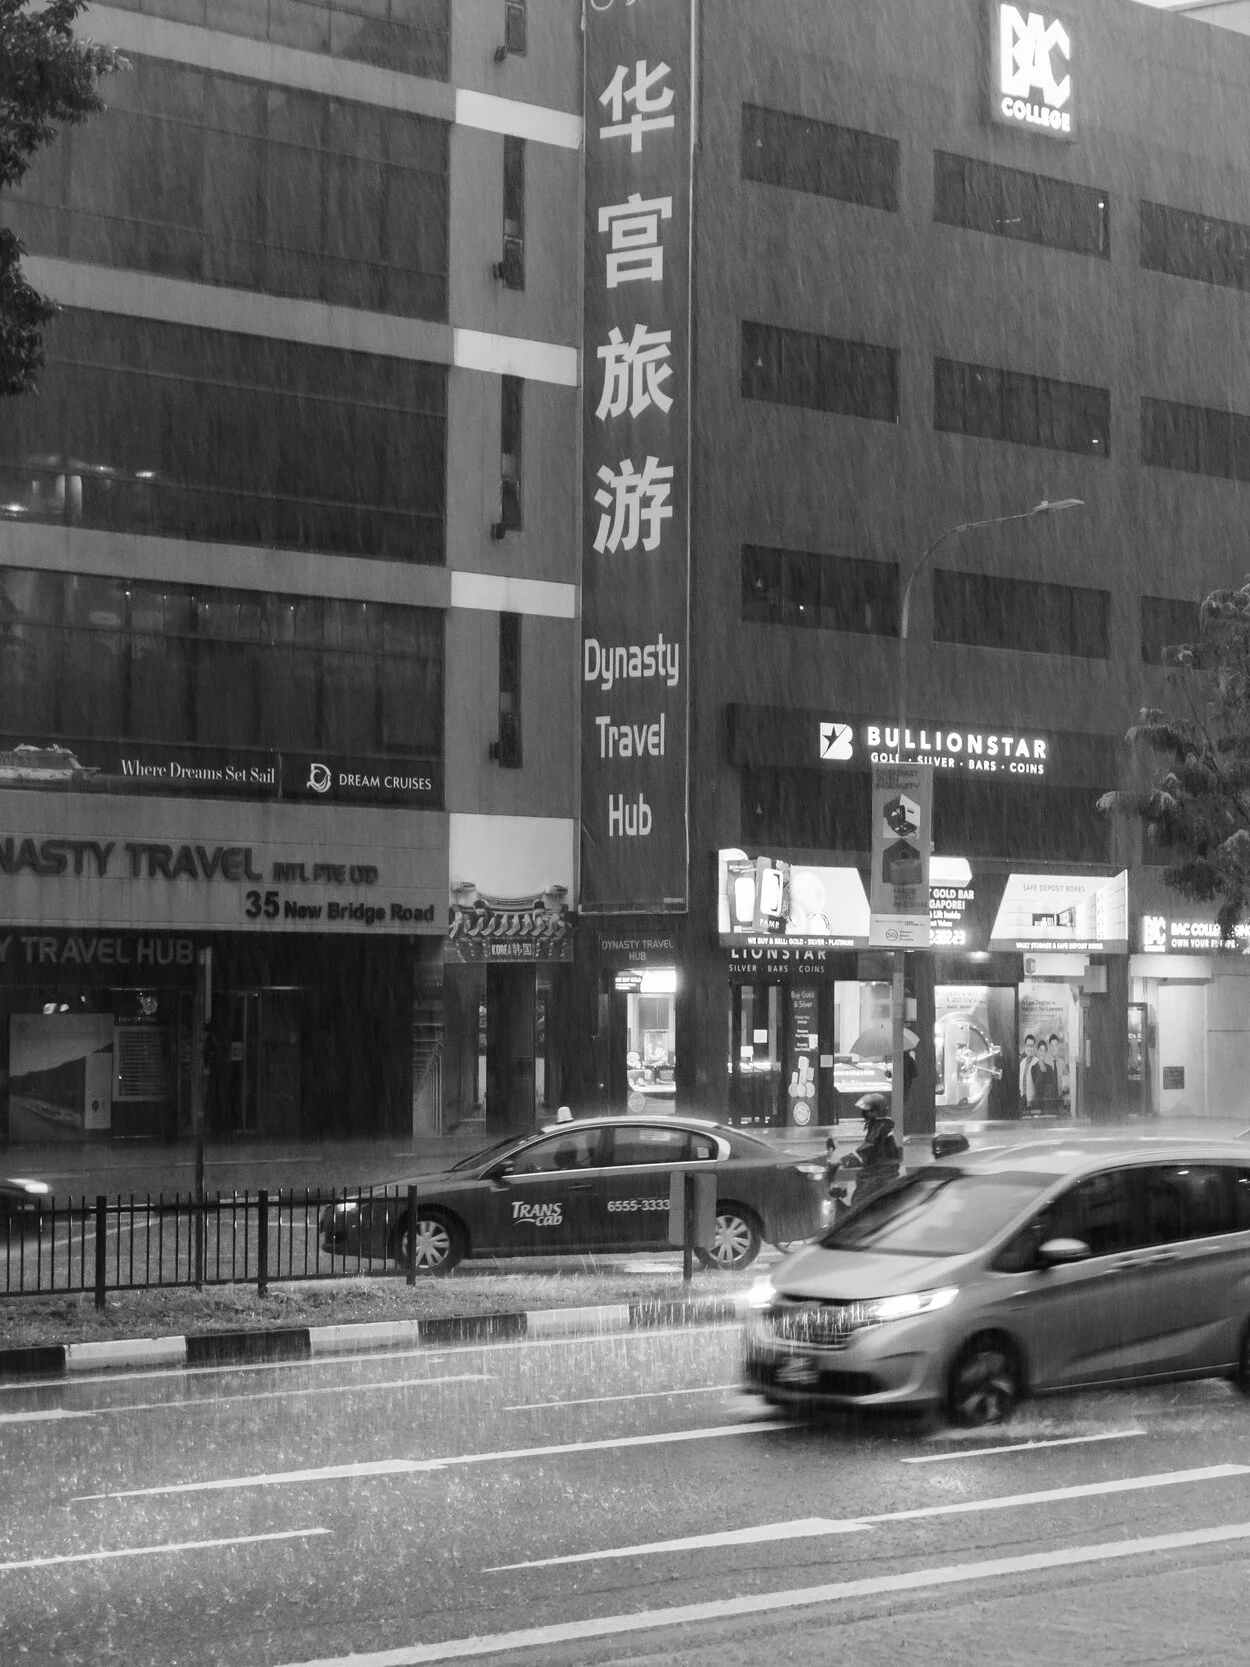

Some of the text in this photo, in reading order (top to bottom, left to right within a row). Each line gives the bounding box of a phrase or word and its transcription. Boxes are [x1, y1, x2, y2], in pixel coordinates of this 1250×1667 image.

[1001, 97, 1070, 132] COLLEGE
[592, 60, 674, 554] 华宫旅游
[584, 633, 679, 690] Dynasty
[595, 712, 665, 758] Travel
[867, 726, 1047, 759] BULLIONSTAR
[871, 752, 1044, 775] GOL SILVER BARS COINS
[121, 759, 275, 784] Where Dreams Set Sail
[339, 774, 380, 788] DREAM
[384, 776, 432, 790] CRUISES
[609, 793, 652, 837] Hub
[125, 842, 263, 882] TRAVEL
[933, 888, 956, 899] GOLD
[958, 889, 975, 900] BAR
[1039, 884, 1064, 892] DEPOSIT
[245, 890, 434, 925] 35 New Bridge Road
[929, 899, 965, 910] GAPORE!
[1171, 922, 1190, 936] BAC
[602, 939, 673, 950] DYNASTY TRAVEL
[748, 937, 757, 945] WE
[758, 937, 769, 945] BUY
[807, 938, 824, 946] SILVER
[1171, 939, 1188, 948] OWN
[1190, 939, 1209, 948] YOUR
[20, 937, 130, 964] TRAVEL
[137, 938, 194, 965] HUB
[491, 944, 512, 955] KOREA
[629, 951, 647, 961] HUB
[729, 964, 825, 973] SILVER BARS COINS
[801, 990, 815, 998] Gold
[511, 1201, 562, 1218] TRANS
[607, 1199, 670, 1212] 6555-3333
[535, 1212, 562, 1226] cab
